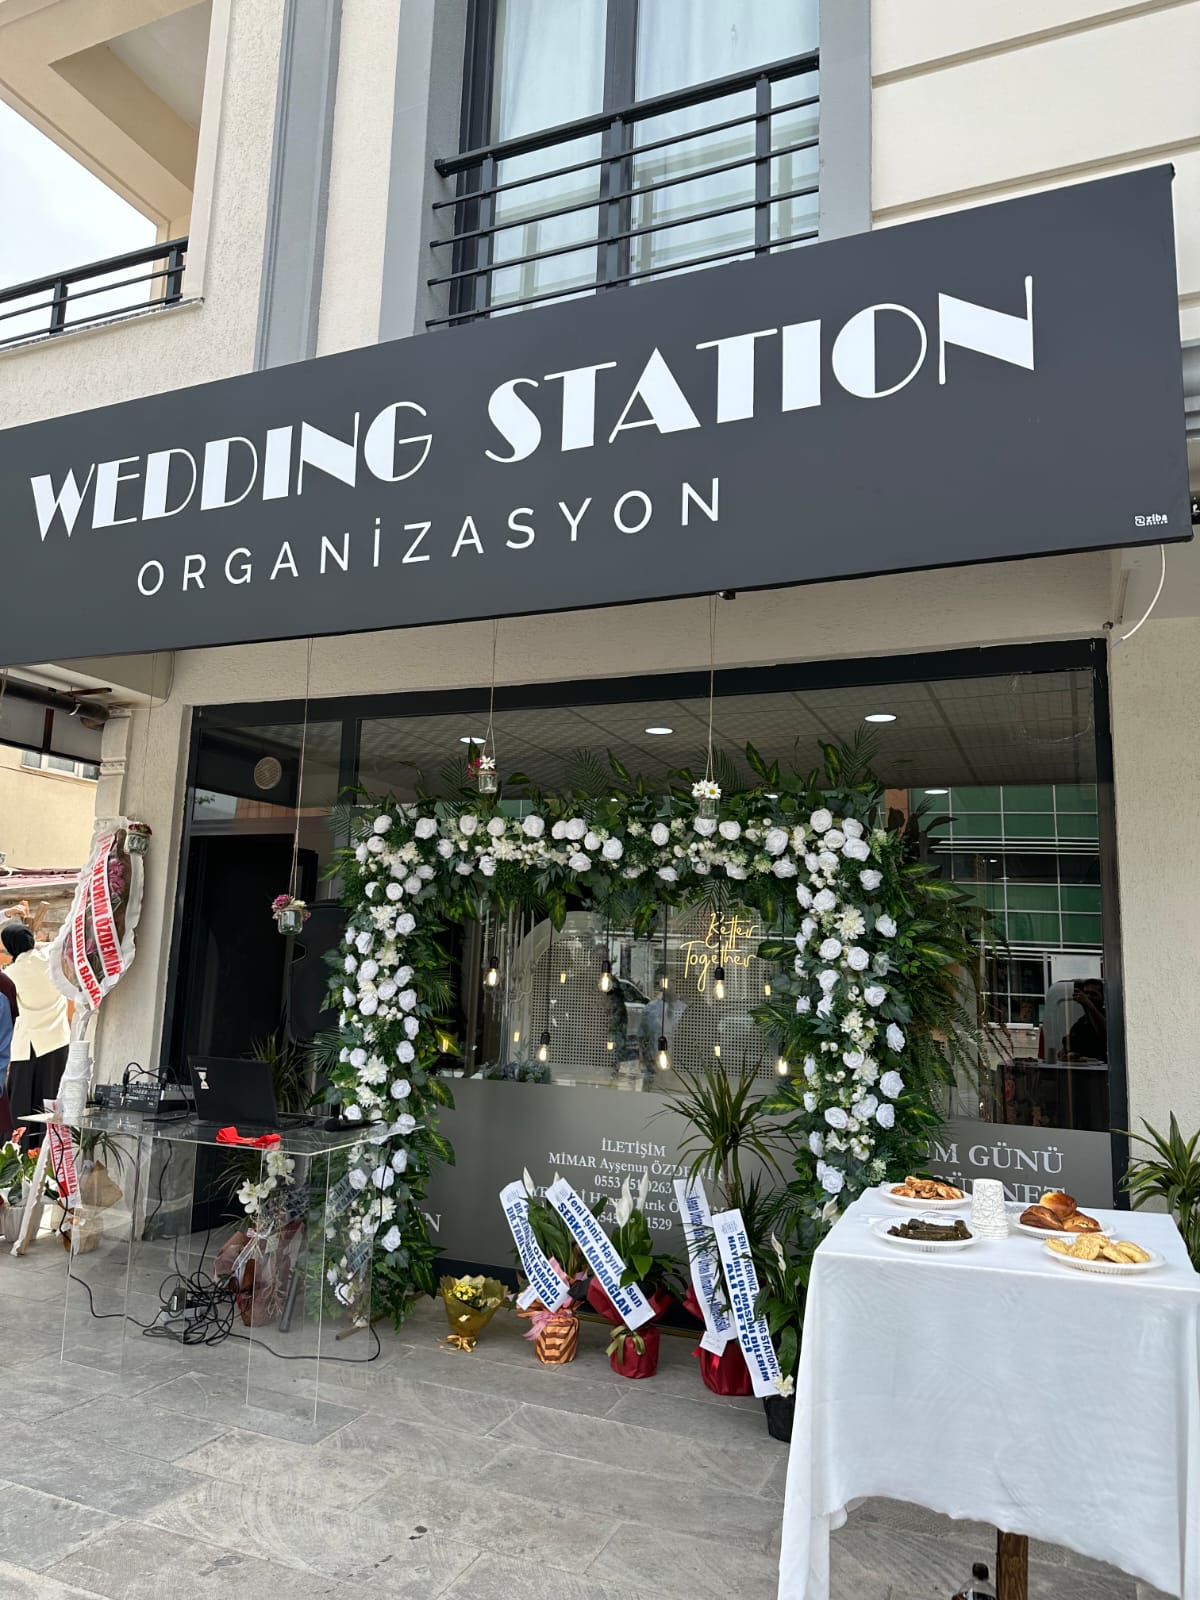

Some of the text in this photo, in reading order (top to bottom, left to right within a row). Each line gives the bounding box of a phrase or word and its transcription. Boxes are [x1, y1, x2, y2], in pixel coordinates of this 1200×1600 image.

[30, 275, 1035, 542] WEDDING STATION
[137, 477, 720, 596] ORGANİZASYON
[94, 876, 109, 917] EVRİM
[95, 916, 123, 977] ÖZDEMİR
[680, 940, 757, 992] Together
[548, 1152, 597, 1168] MİMAR
[600, 1159, 648, 1175] Ayşenur
[601, 1137, 666, 1158] İLETİŞİM
[968, 1141, 1064, 1174] GÜNÜ
[594, 1174, 621, 1189] 0553
[567, 1192, 586, 1216] Yeni
[647, 1216, 673, 1231] 1529
[533, 1246, 560, 1286] OLSUN
[558, 1202, 591, 1248] SERKAN
[585, 1246, 632, 1316] KARAOĞLAN
[531, 1274, 556, 1308] YILDIZ
[533, 1262, 560, 1300] KARAKOL
